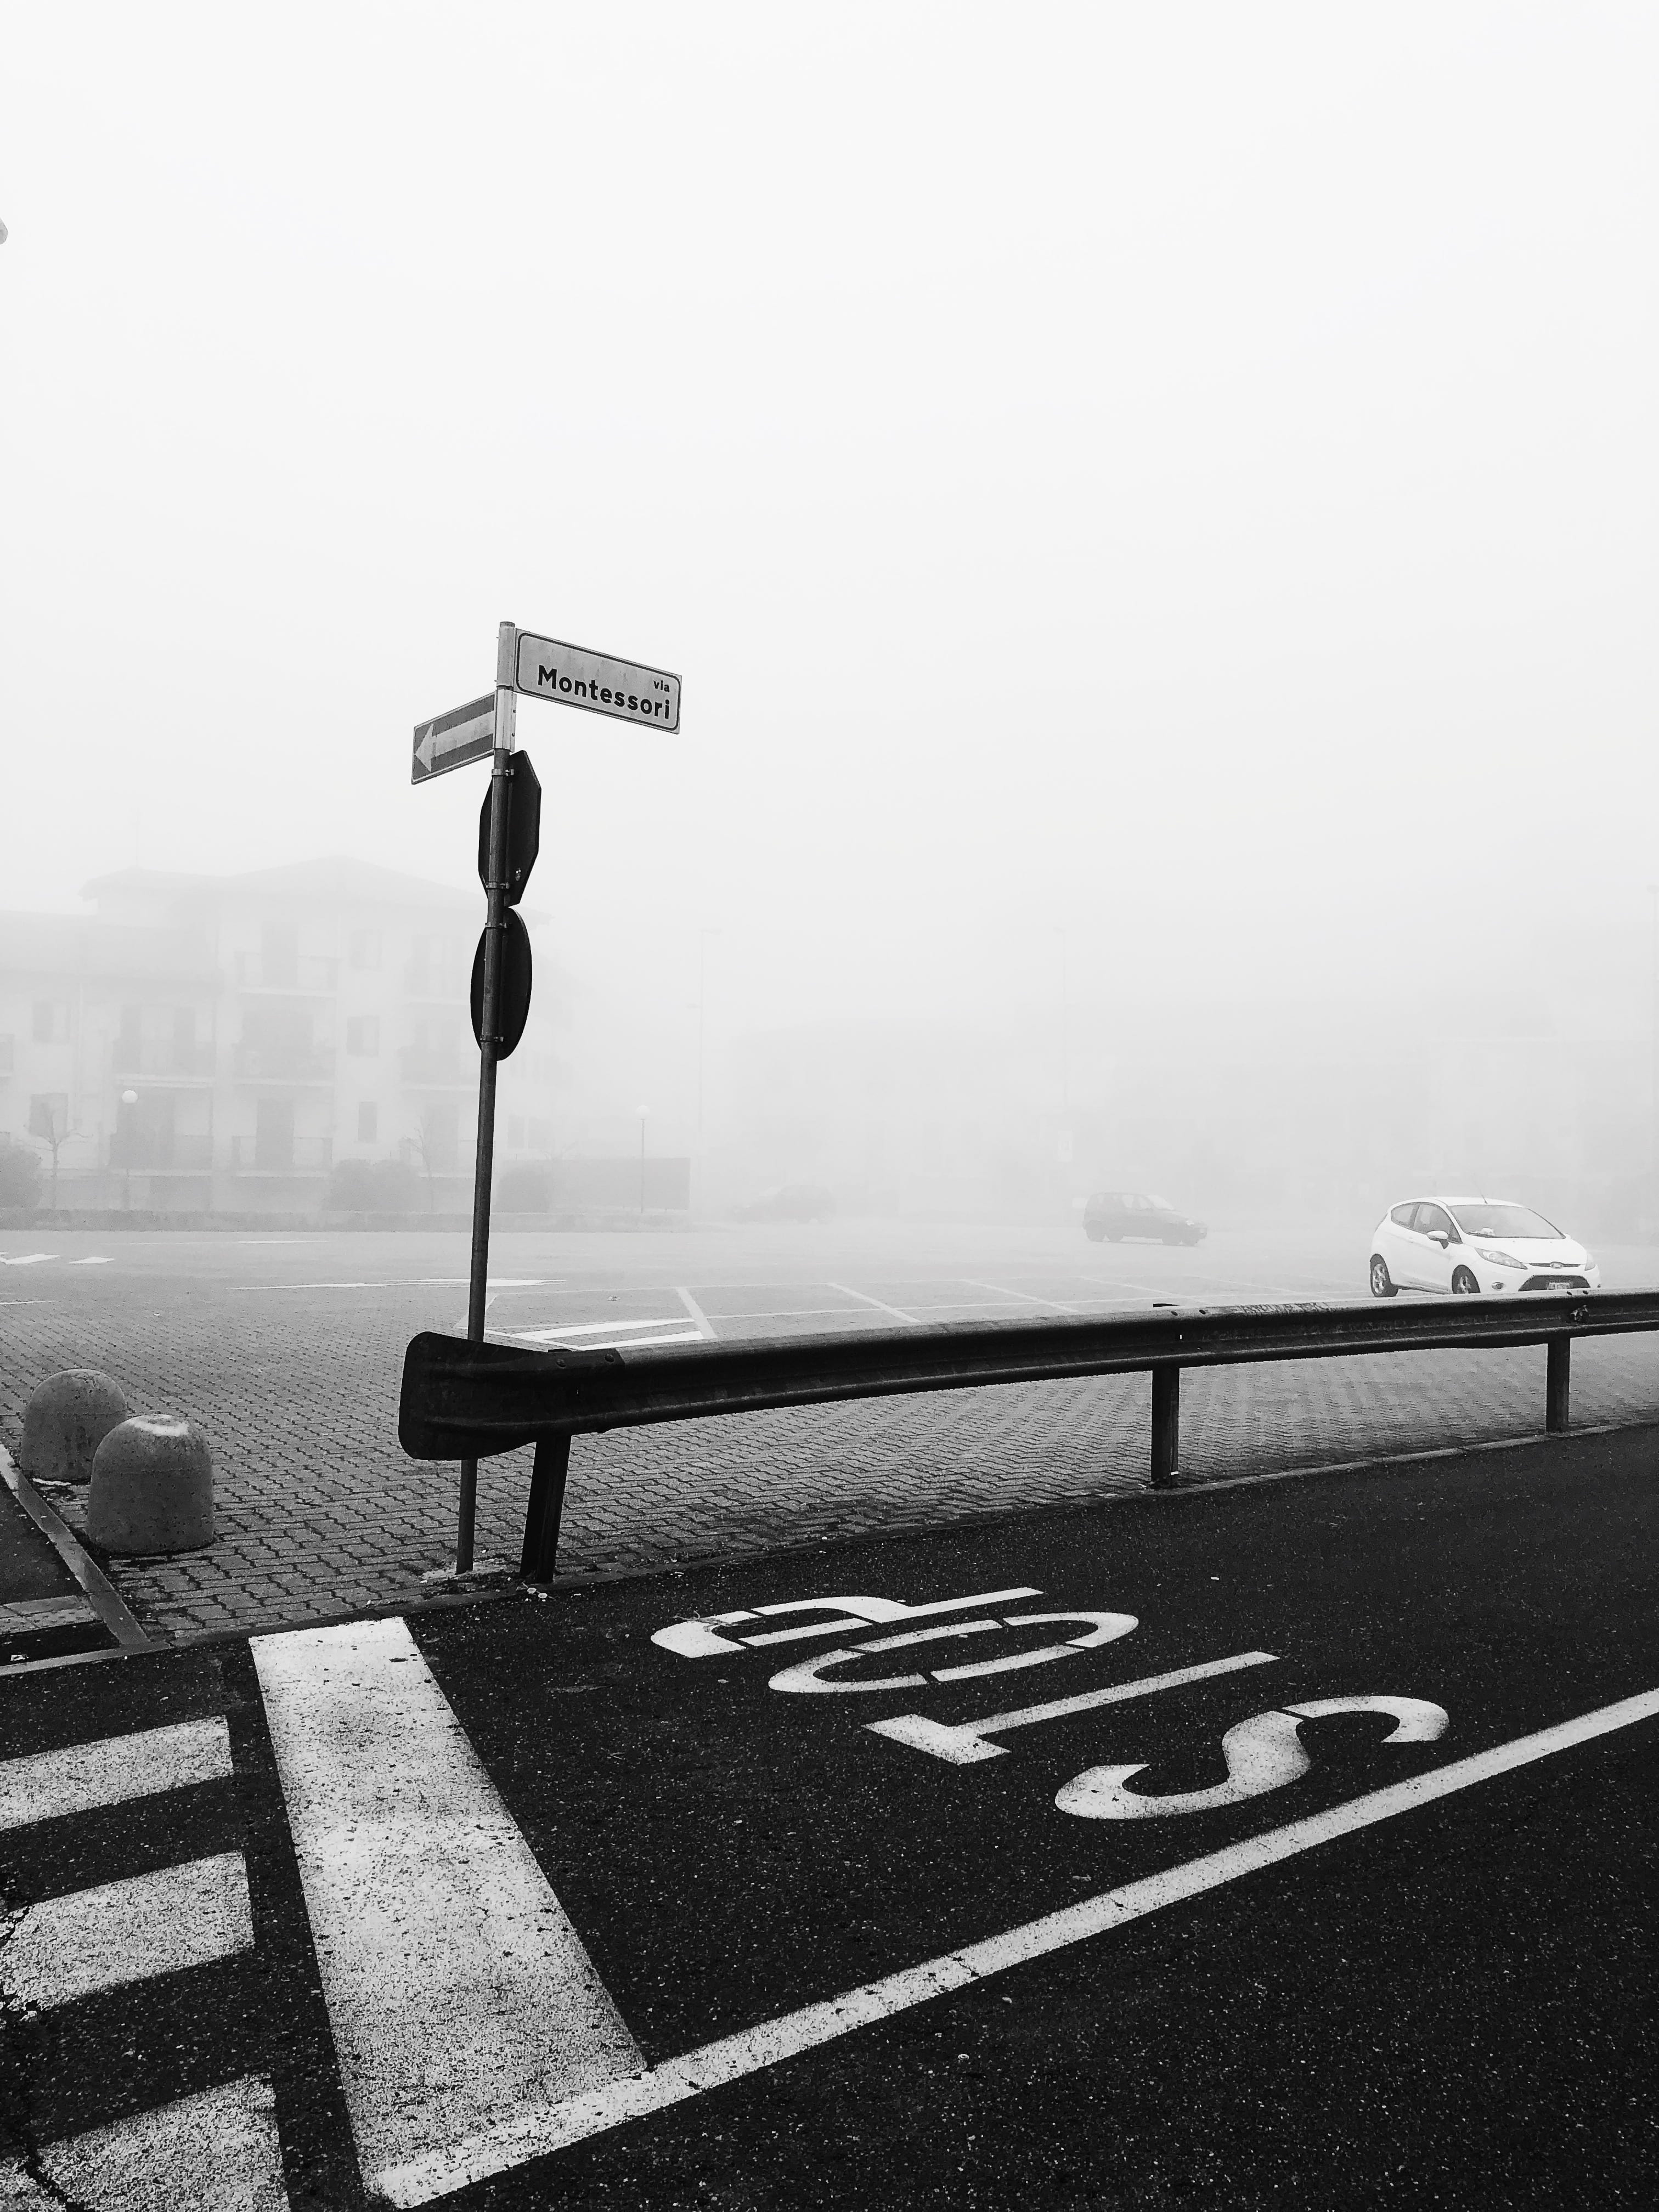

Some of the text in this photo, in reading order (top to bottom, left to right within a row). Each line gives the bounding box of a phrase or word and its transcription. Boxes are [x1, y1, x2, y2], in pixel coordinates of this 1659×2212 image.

[538, 664, 670, 720] Montessori
[653, 680, 670, 693] via
[651, 1587, 1449, 1820] STOP
